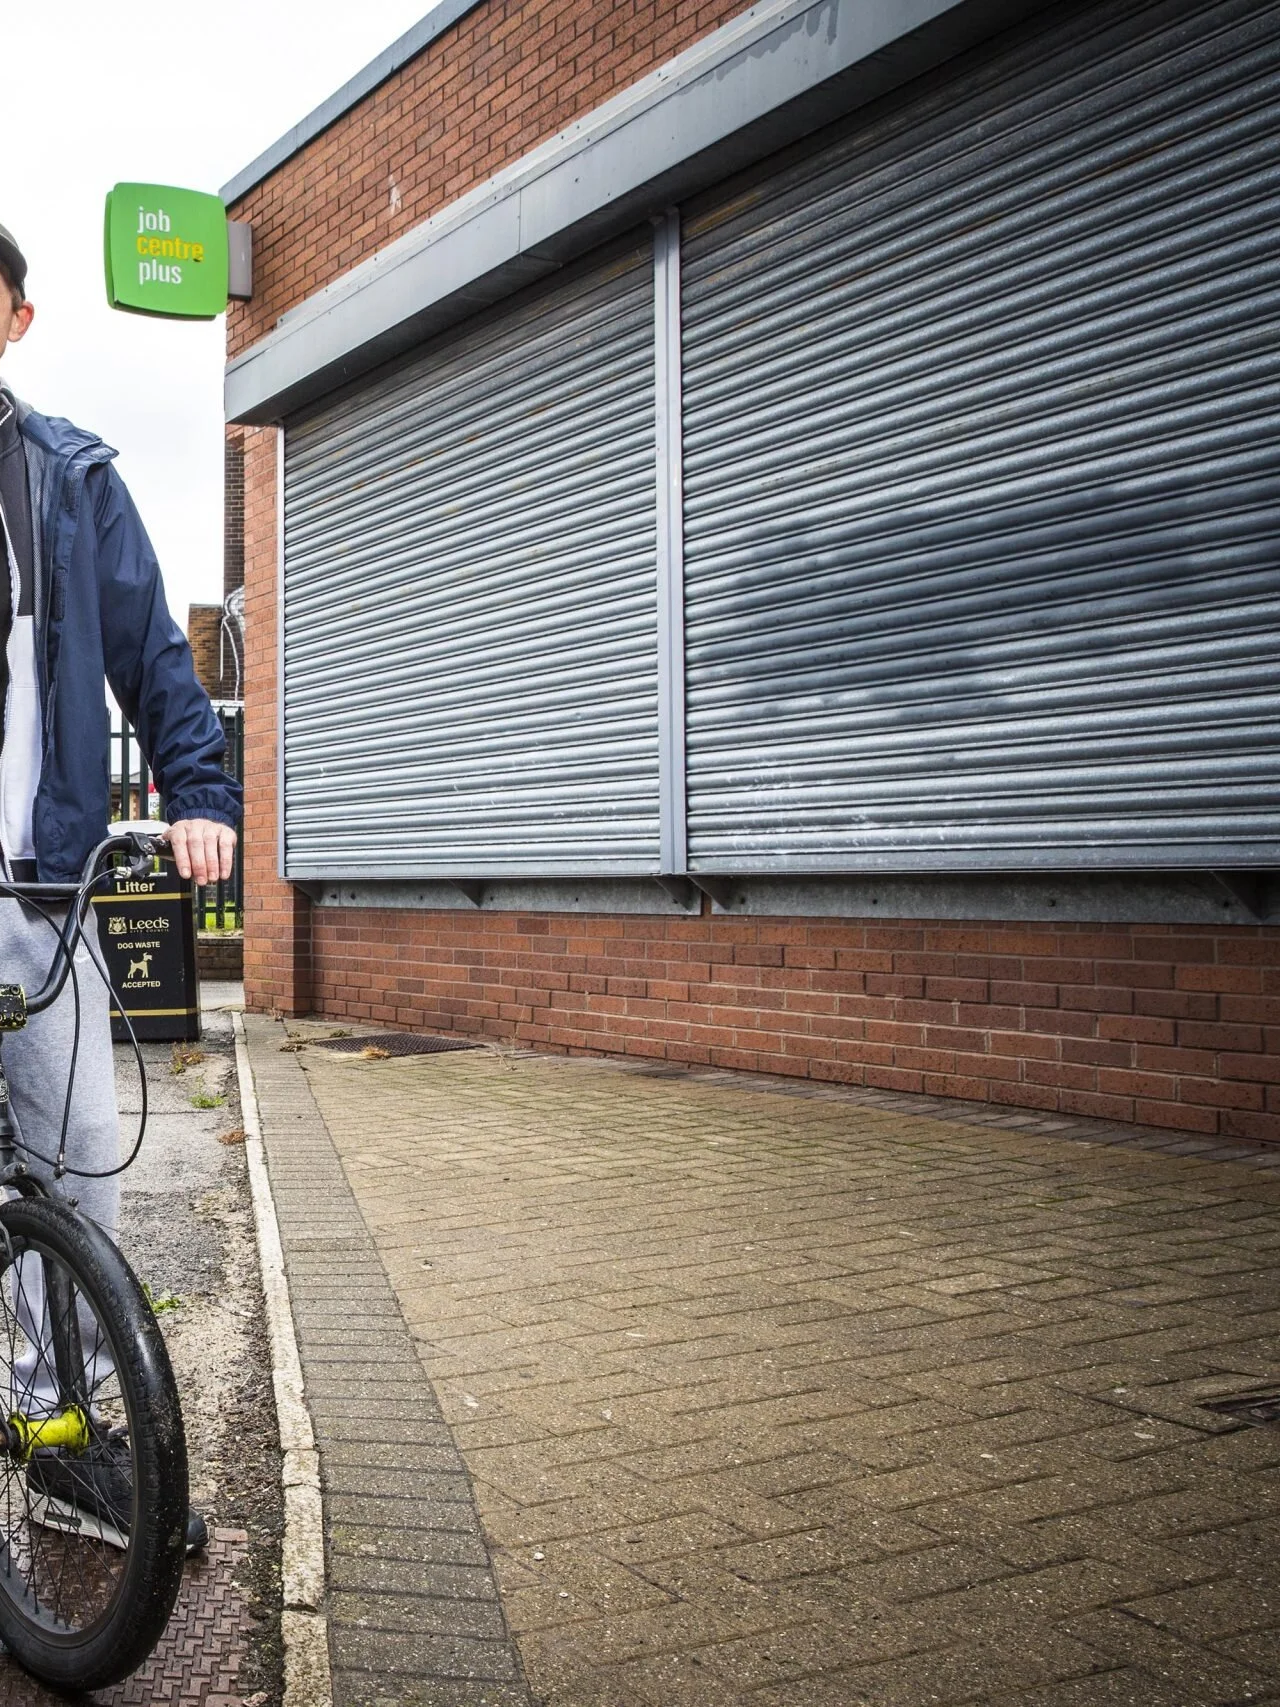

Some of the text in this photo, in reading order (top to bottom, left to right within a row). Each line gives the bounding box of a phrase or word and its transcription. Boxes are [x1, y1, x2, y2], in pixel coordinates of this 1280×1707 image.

[137, 206, 170, 233] job
[136, 235, 204, 262] centre
[138, 259, 182, 285] plus
[116, 881, 155, 893] Litter
[129, 917, 169, 930] Leeds
[135, 941, 160, 949] WASTE
[122, 981, 161, 989] ACCEPTED
